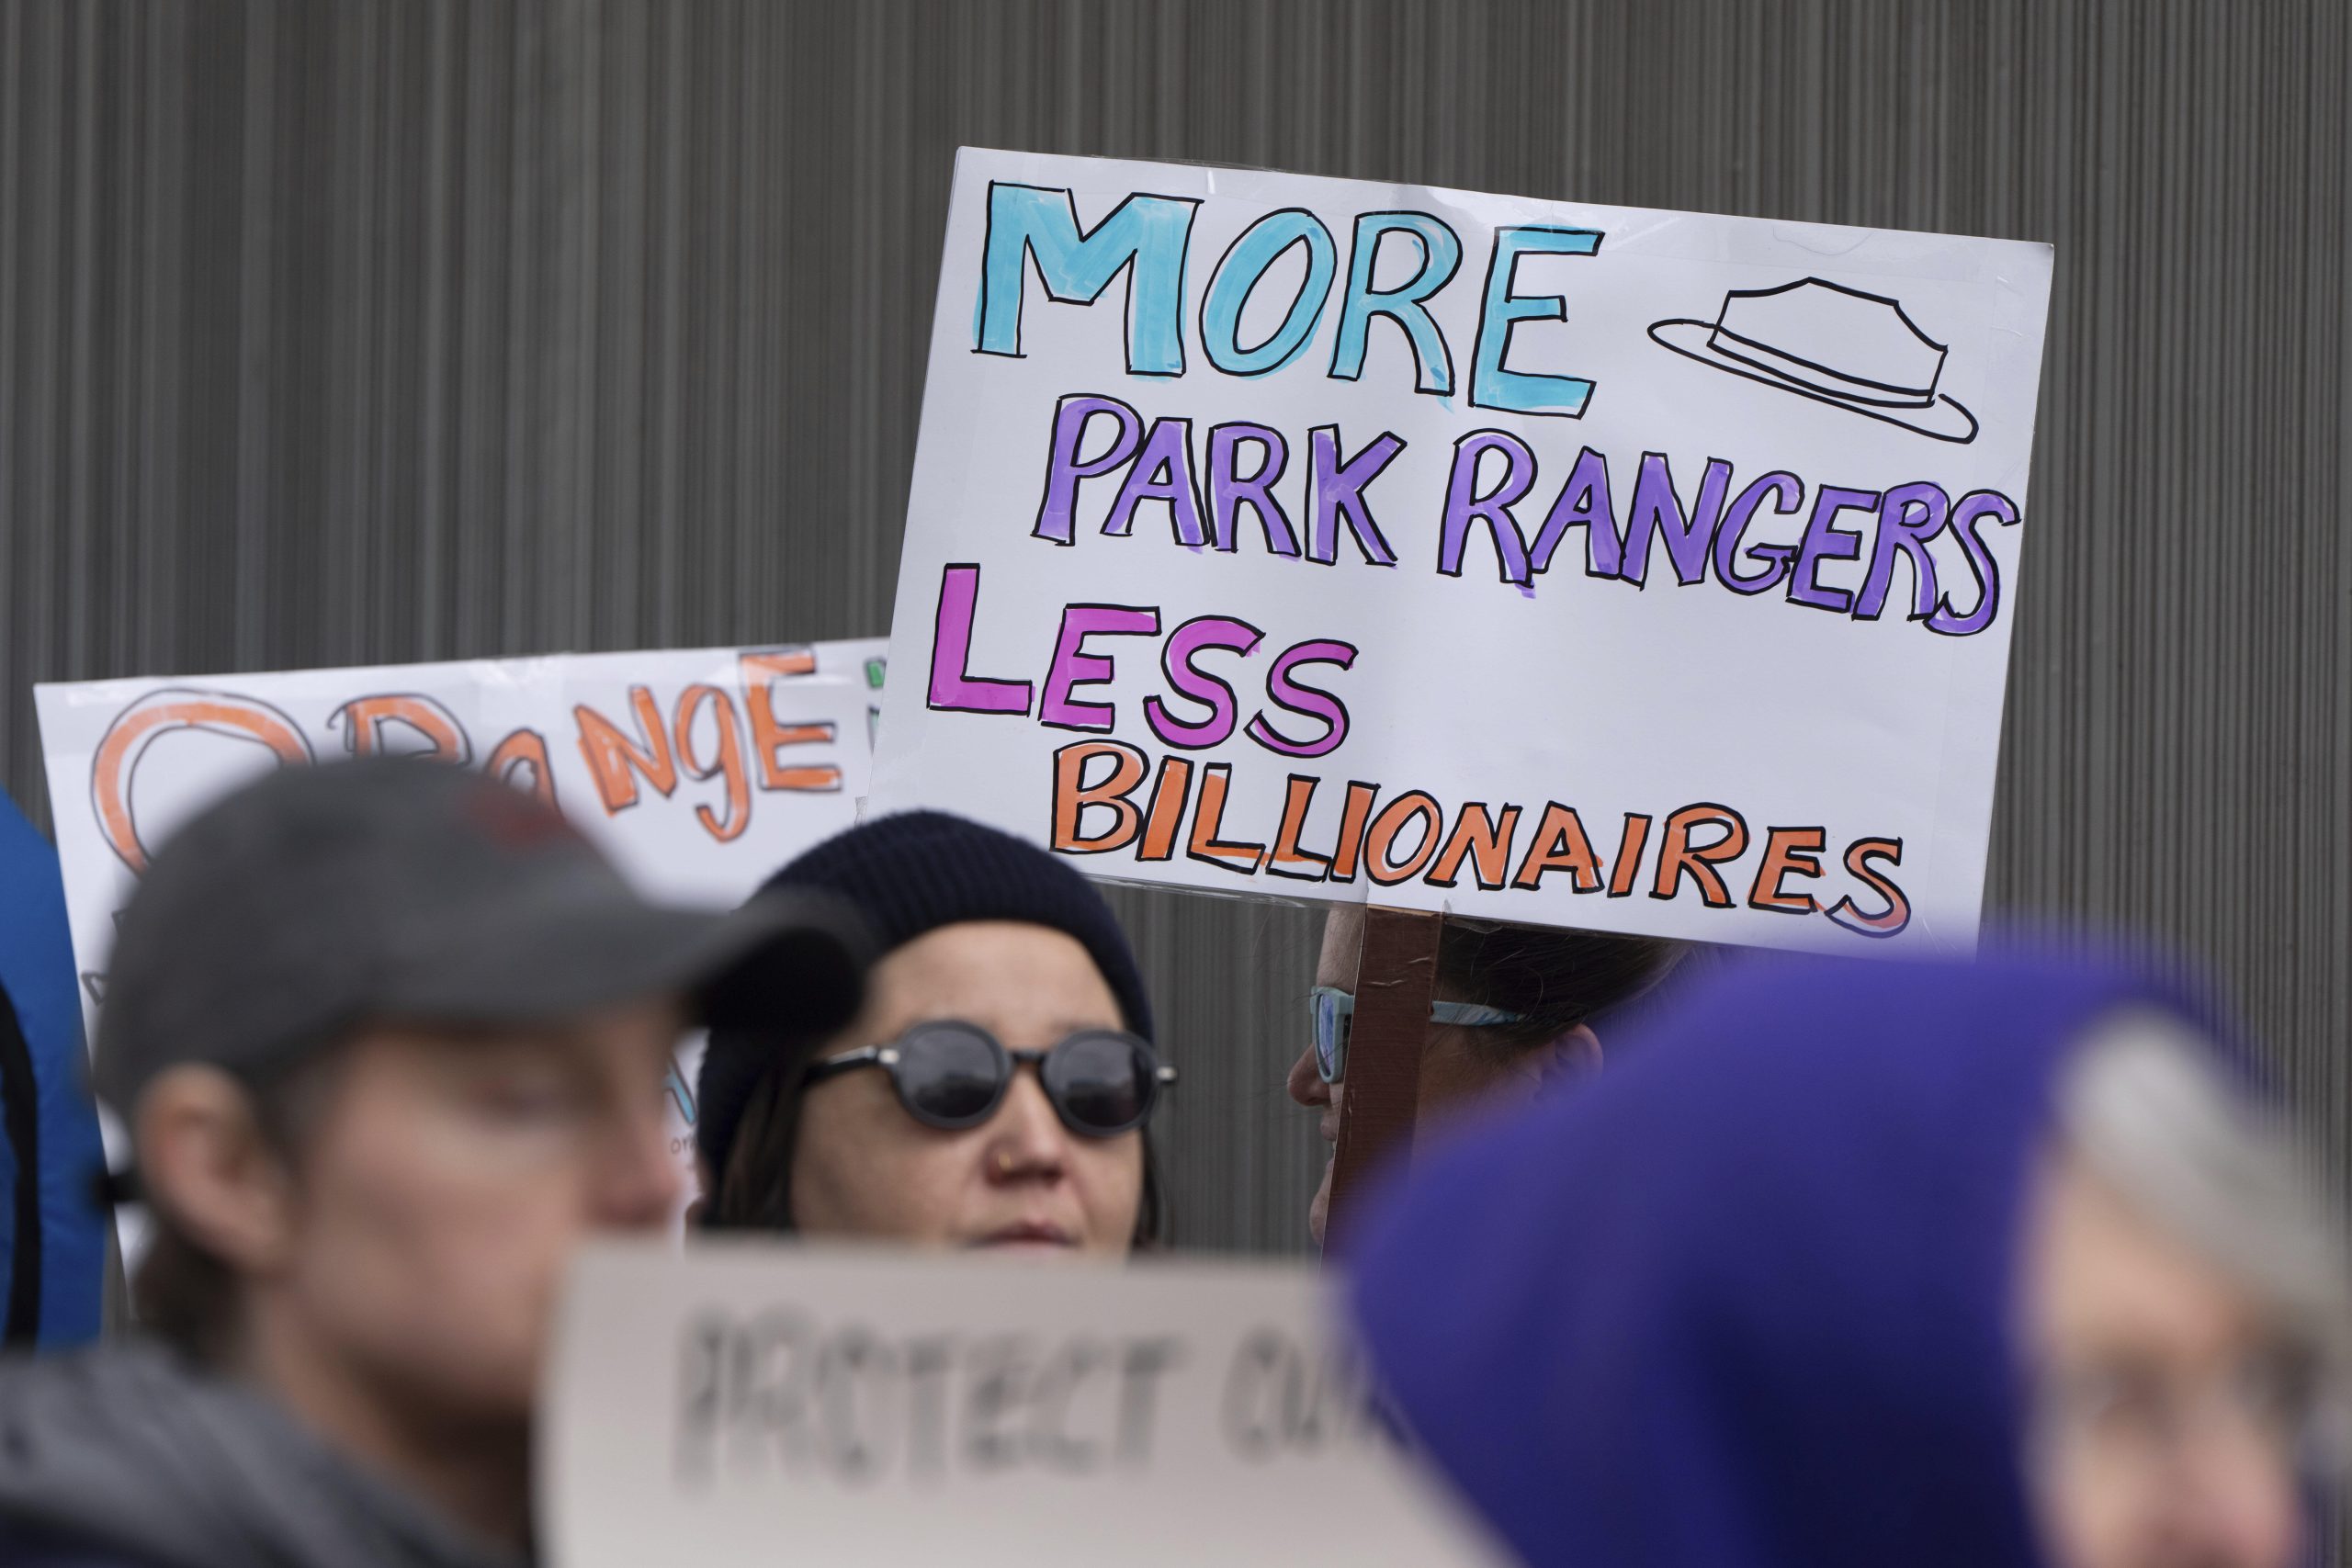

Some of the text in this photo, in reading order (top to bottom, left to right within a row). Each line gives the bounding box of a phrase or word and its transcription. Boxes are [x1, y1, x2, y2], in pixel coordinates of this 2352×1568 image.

[971, 180, 1605, 418] MORE
[1032, 393, 2022, 636] PARK RANGERS
[928, 562, 1359, 758] LESS
[1051, 739, 1913, 938] BILLIONAIRES
[673, 1306, 1191, 1499] PROTECT
